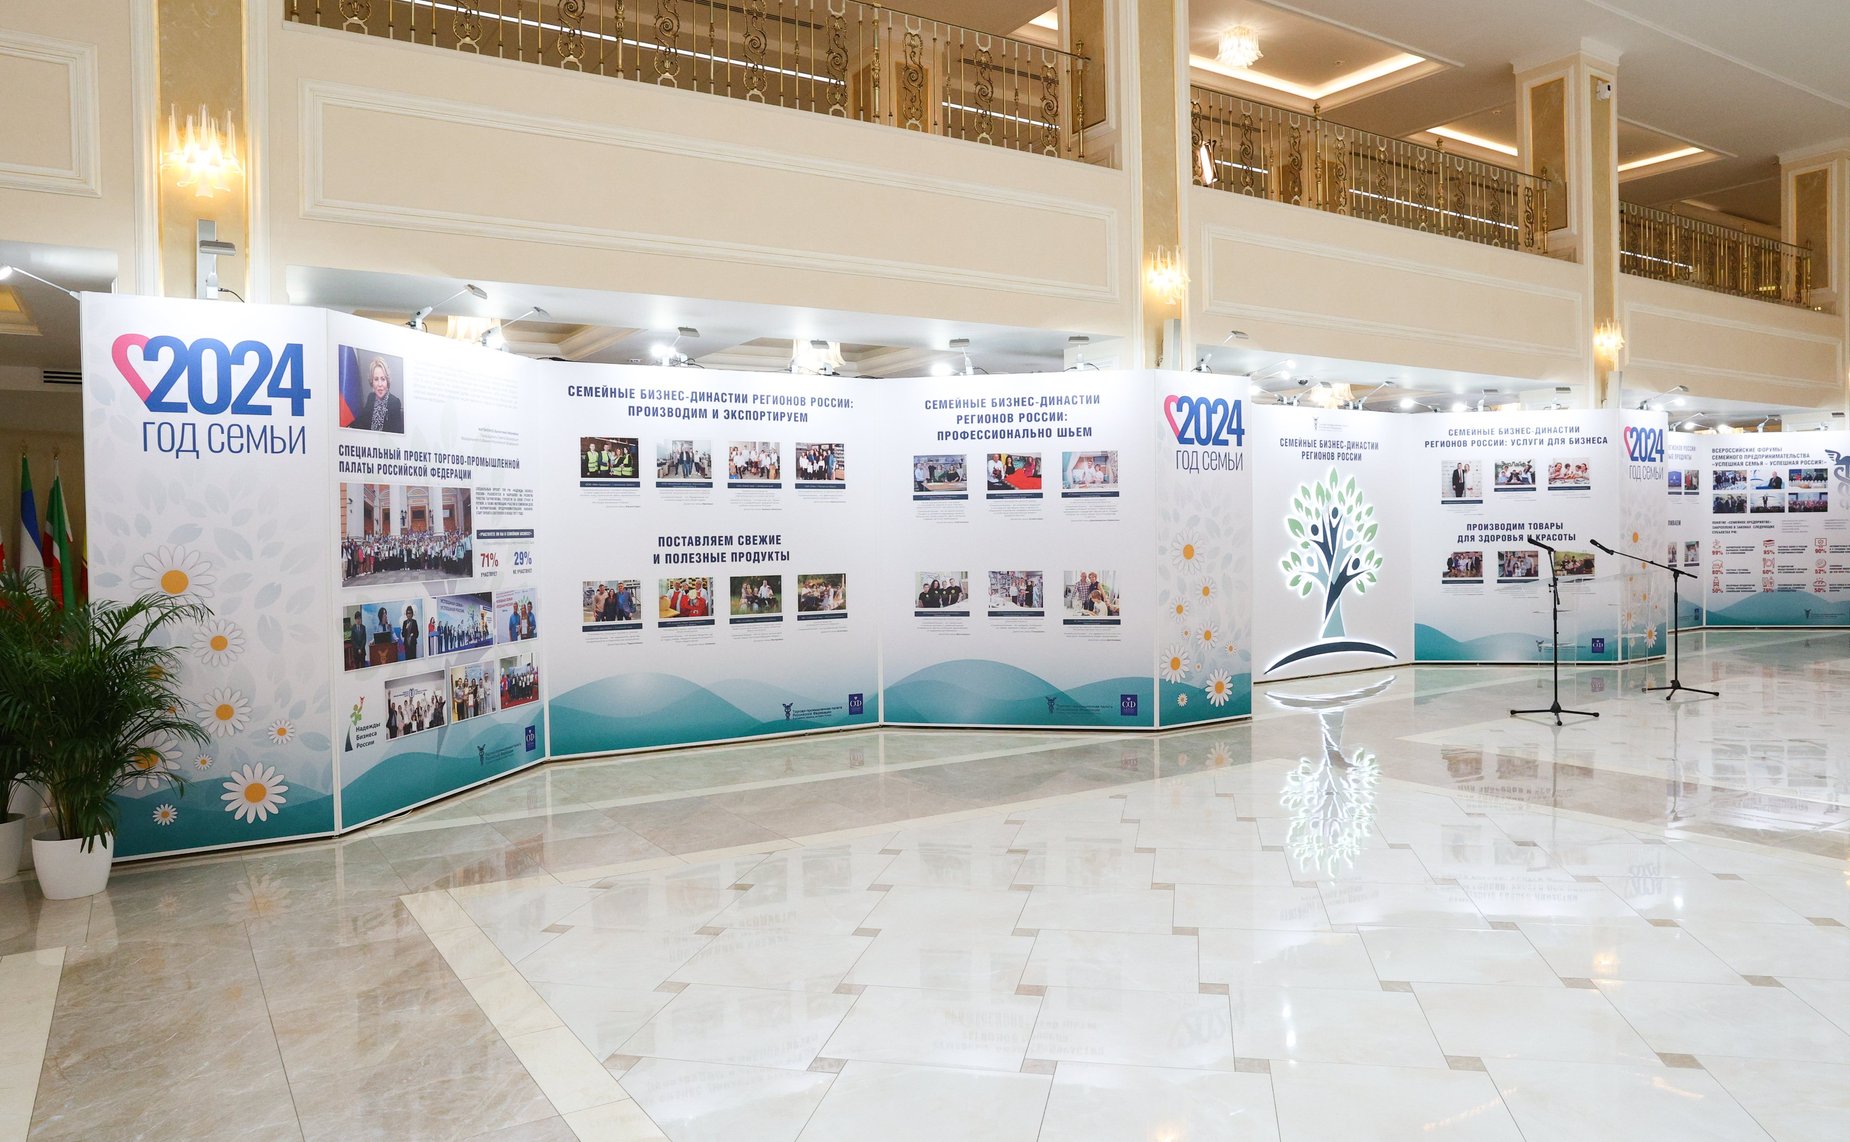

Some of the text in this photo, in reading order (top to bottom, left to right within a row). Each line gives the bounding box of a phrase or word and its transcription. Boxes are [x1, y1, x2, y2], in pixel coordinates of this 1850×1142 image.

[143, 335, 311, 417] 2024
[568, 384, 854, 409] СЕМЕЙНЫЕ БИЗНЕС-ДИНАСТИИ РЕГИОНОВ РОССИИ:
[925, 394, 1100, 410] СЕМЕЙНЫЕ БИЗНЕС-ДИНАСТИИ
[628, 405, 808, 423] ПРОИЗВОДИМ И ЭКСПОРТИРУЕМ
[956, 412, 1068, 424] РЕГИОНОВ РОССИИ:
[1176, 395, 1245, 446] 2024
[937, 426, 1092, 441] ПРОФЕССИОНАЛЬНО ШЬЕМ
[1448, 426, 1580, 436] СЕМЕЙНЫЕ БИЗНЕС-ДИНАСТИИ
[1280, 437, 1379, 451] СЕМЕЙНЫЕ БИЗНЕС-ДИНАСТИИ
[1425, 436, 1608, 448] РЕГИОНОВ РОССИИ: УСЛУГИ ДЛЯ БИЗНЕСА
[1630, 426, 1664, 462] 2024
[339, 444, 520, 470] СПЕЦИАЛЬНЫЙ ПРОЕКТ ТОРГОВО-ПРОМЫШЛЕННОЙ
[1301, 451, 1362, 461] РЕГИОНОВ РОССИИ
[339, 461, 472, 481] ПАЛАТЫ РОССИЙСКОЙ ФЕДЕРАЦИИ
[1466, 522, 1563, 532] ПРОИЗВОДИМ ТОВАРЫ
[658, 534, 782, 547] ПОСТАВЛЯЕМ СВЕЖИЕ
[1457, 534, 1475, 543] ДЛЯ
[1478, 534, 1524, 543] ЗДОРОВЬЯ
[1535, 533, 1576, 542] КРАСОТЫ
[481, 553, 499, 567] 71%
[514, 551, 532, 565] 29%
[653, 550, 790, 564] И ПОЛЕЗНЫЕ ПРОДУКТЫ
[355, 722, 381, 733] Надежды
[356, 732, 378, 741] Бизнеса
[356, 740, 375, 749] России
